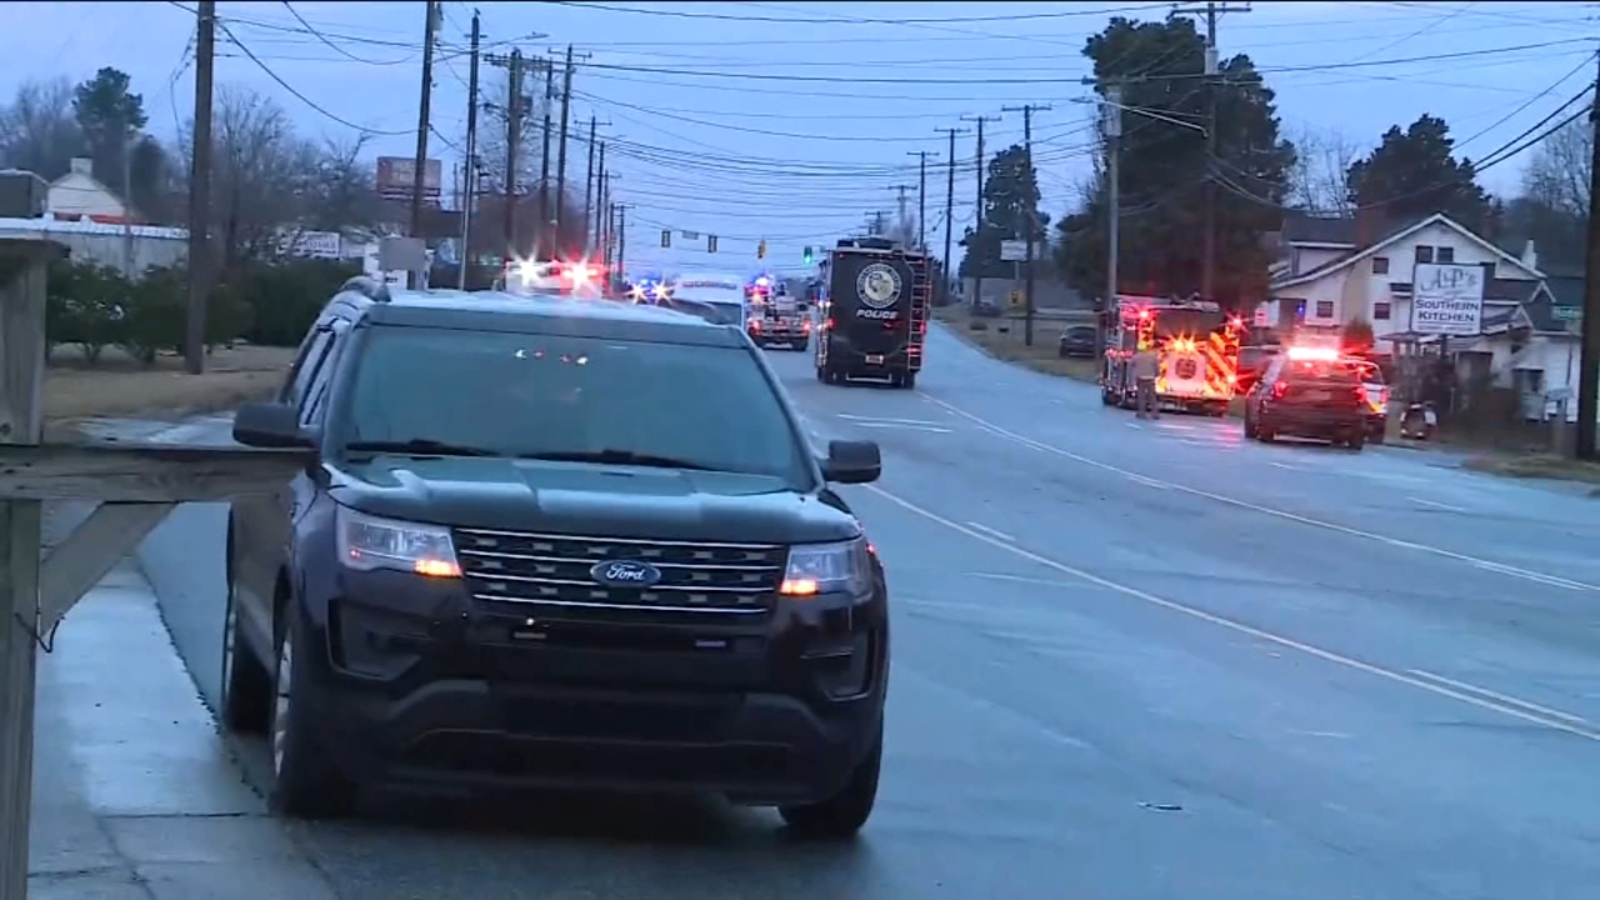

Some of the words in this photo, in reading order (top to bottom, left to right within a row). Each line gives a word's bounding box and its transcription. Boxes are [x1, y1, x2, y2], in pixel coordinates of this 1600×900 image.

[1415, 299, 1479, 311] SOUTHERN
[856, 309, 898, 319] POLICE
[1418, 311, 1475, 321] KITCHEN
[605, 563, 646, 581] Ford
